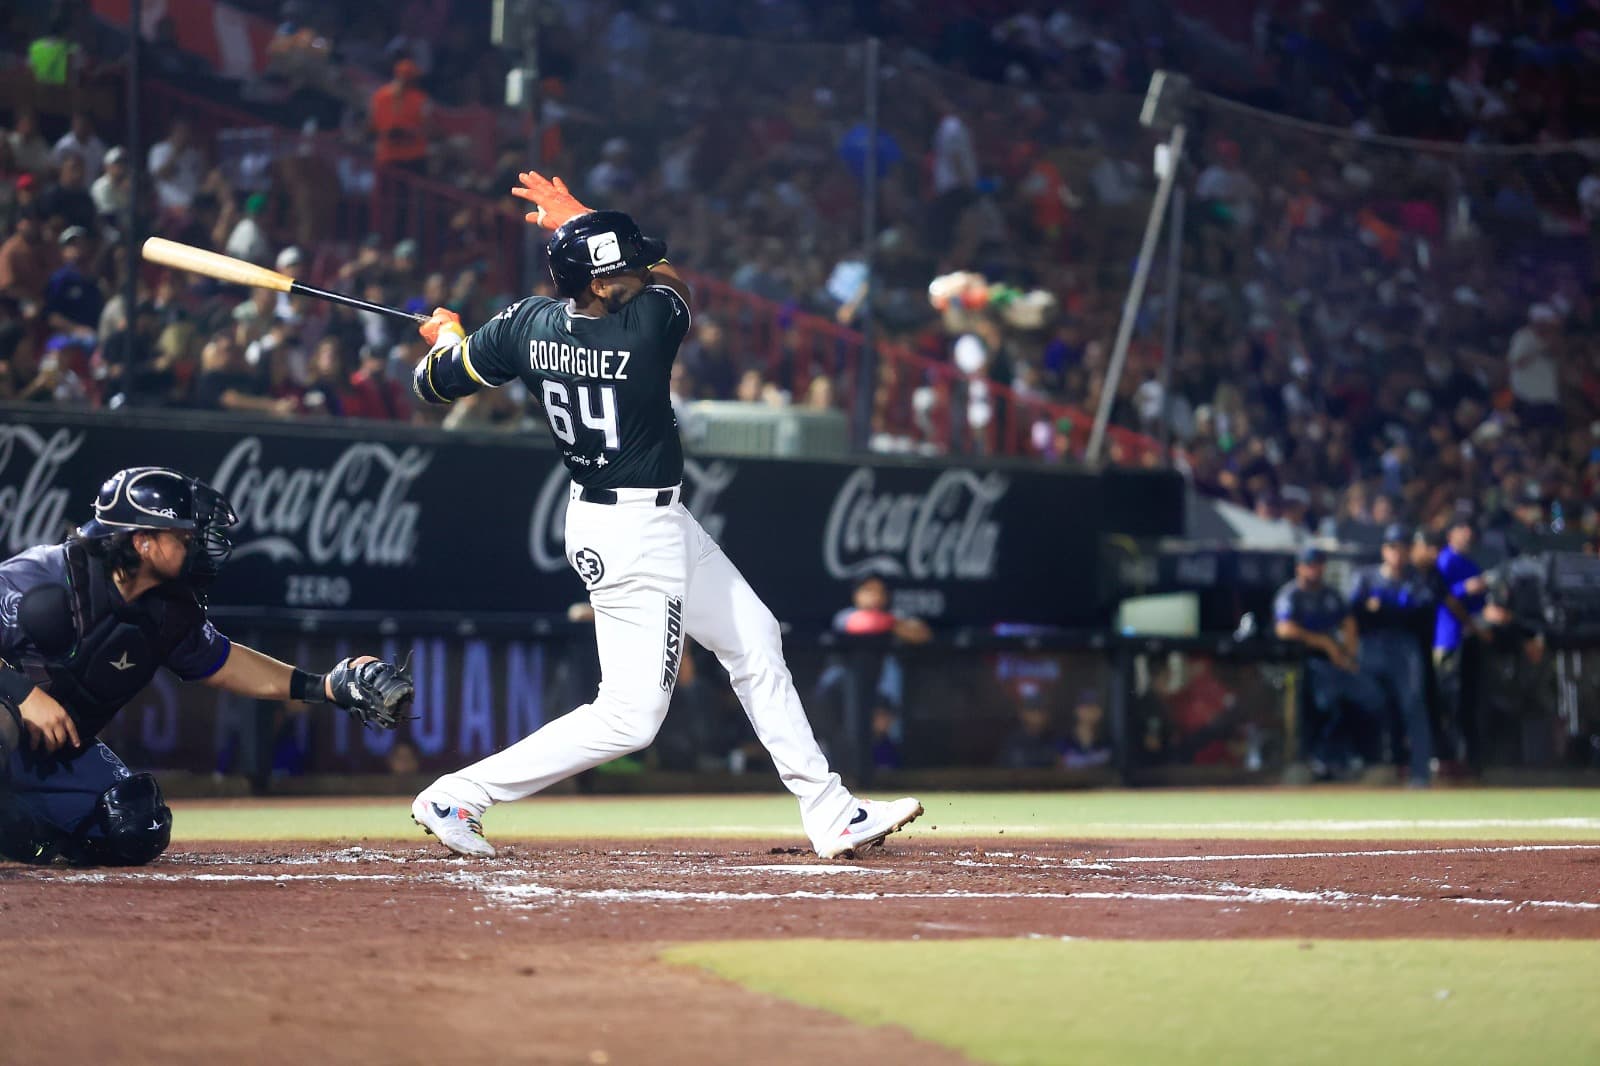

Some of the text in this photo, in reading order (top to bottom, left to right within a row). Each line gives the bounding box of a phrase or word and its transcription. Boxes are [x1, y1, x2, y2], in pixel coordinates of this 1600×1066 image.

[529, 339, 631, 380] RODRIGUEZ
[541, 379, 619, 449] 64
[285, 575, 352, 607] ZERO
